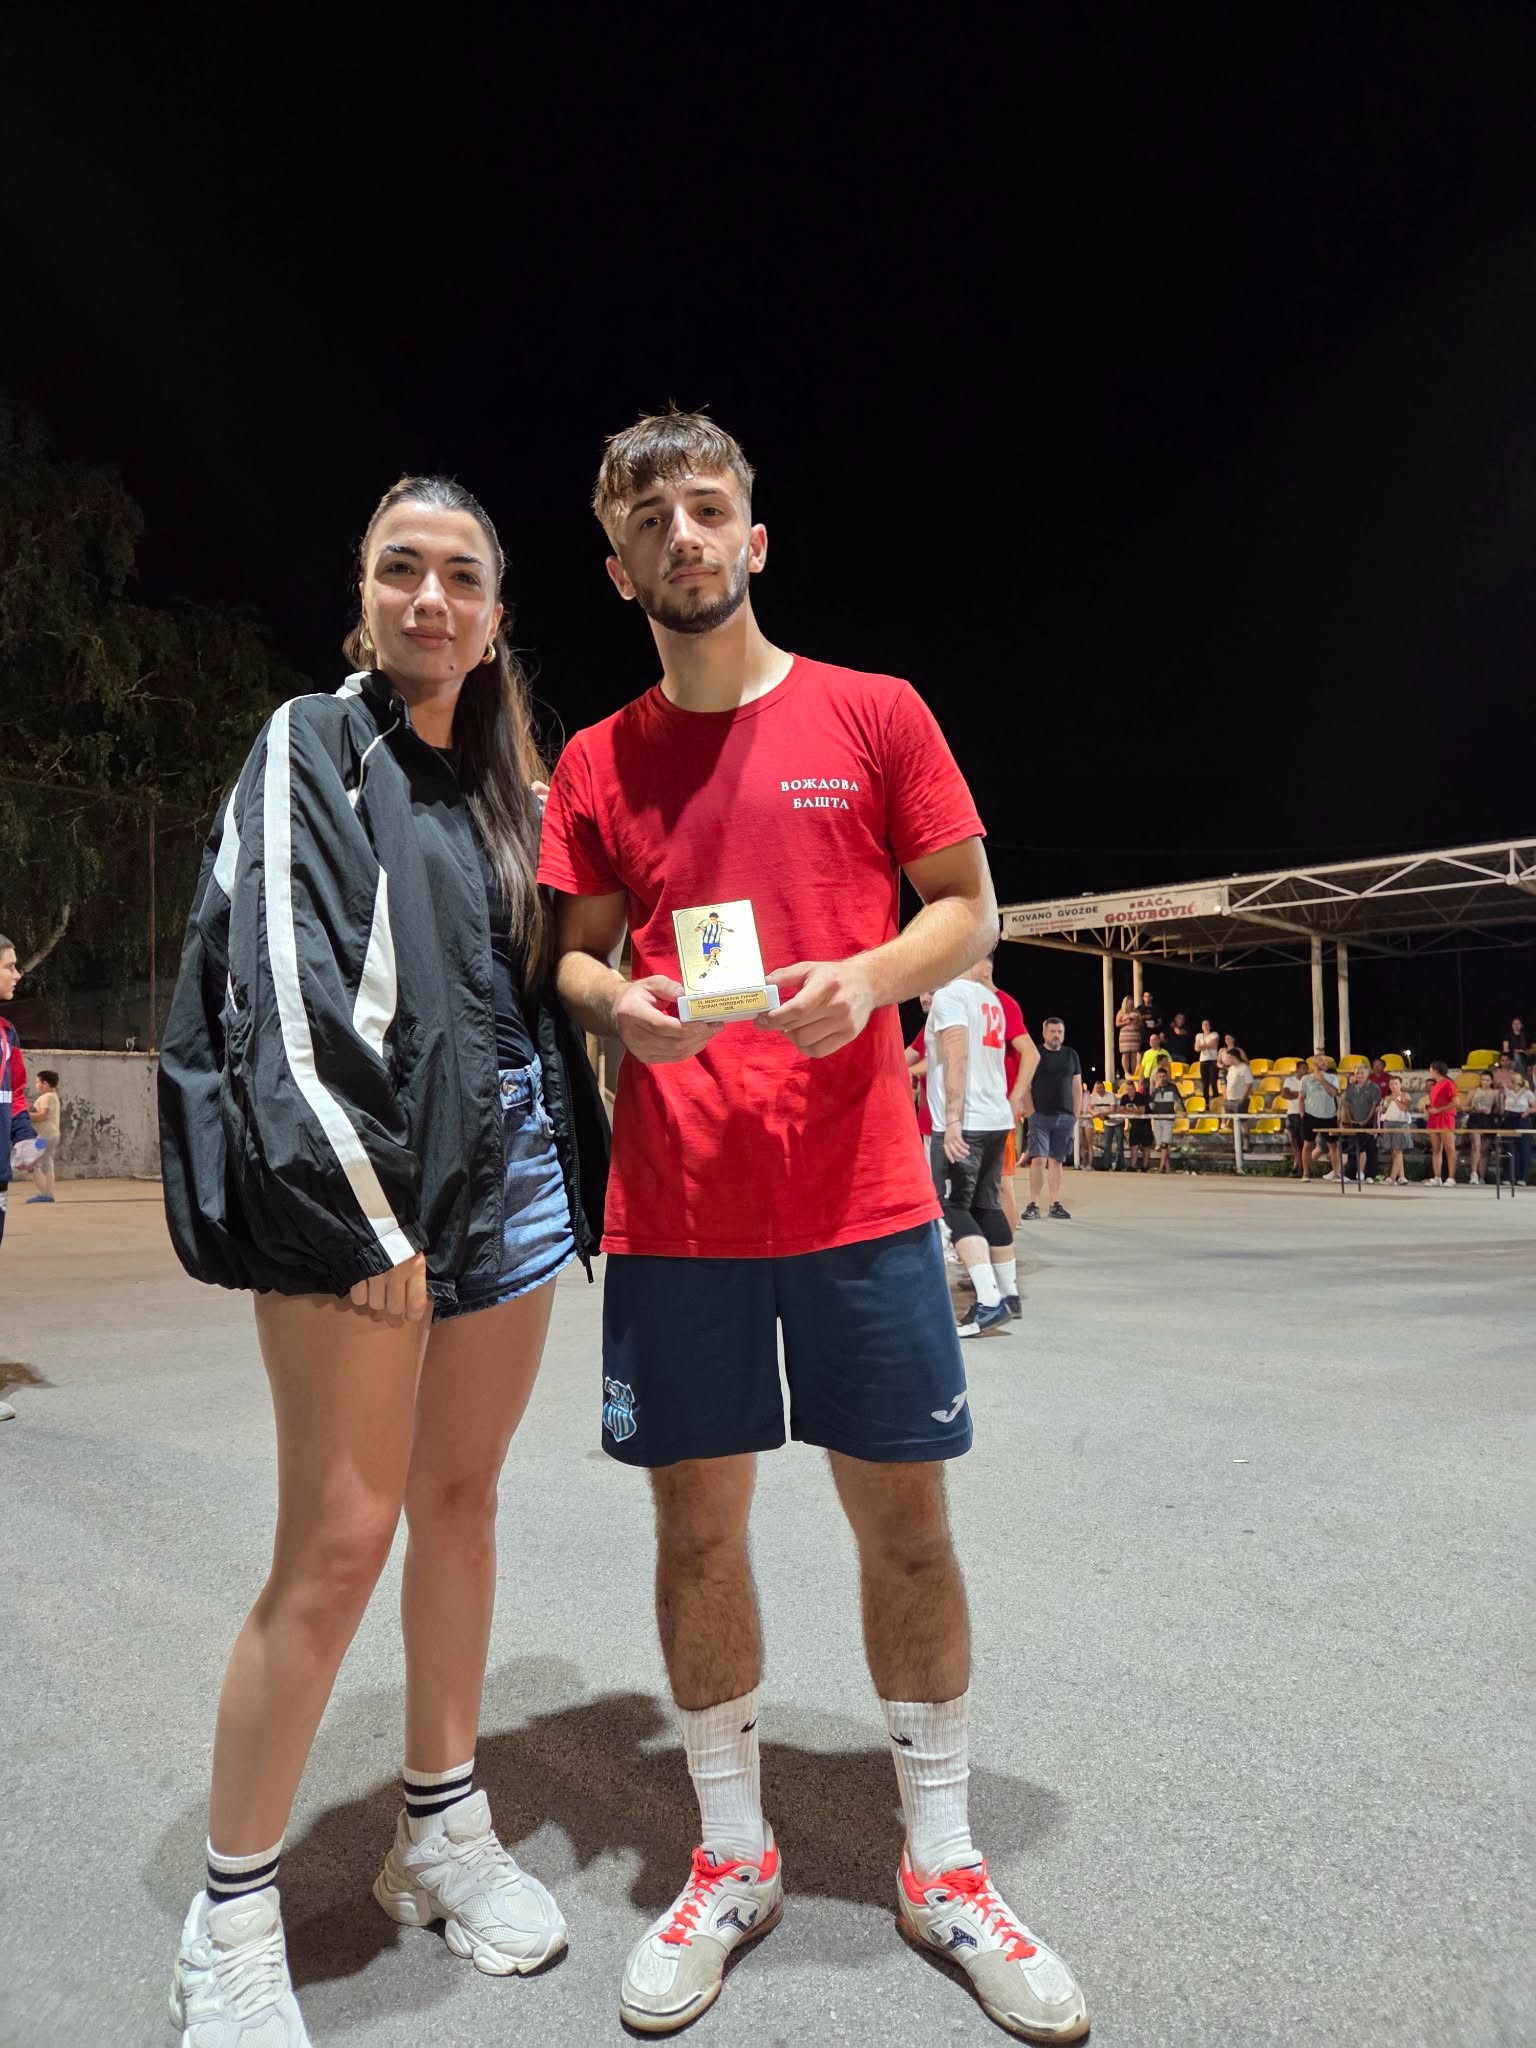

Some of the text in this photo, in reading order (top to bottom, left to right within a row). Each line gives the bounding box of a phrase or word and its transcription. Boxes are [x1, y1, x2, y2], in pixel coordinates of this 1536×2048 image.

[780, 778, 859, 792] ВОЖДОВА
[793, 796, 849, 809] БАШТА
[1011, 911, 1052, 923] KOVANO
